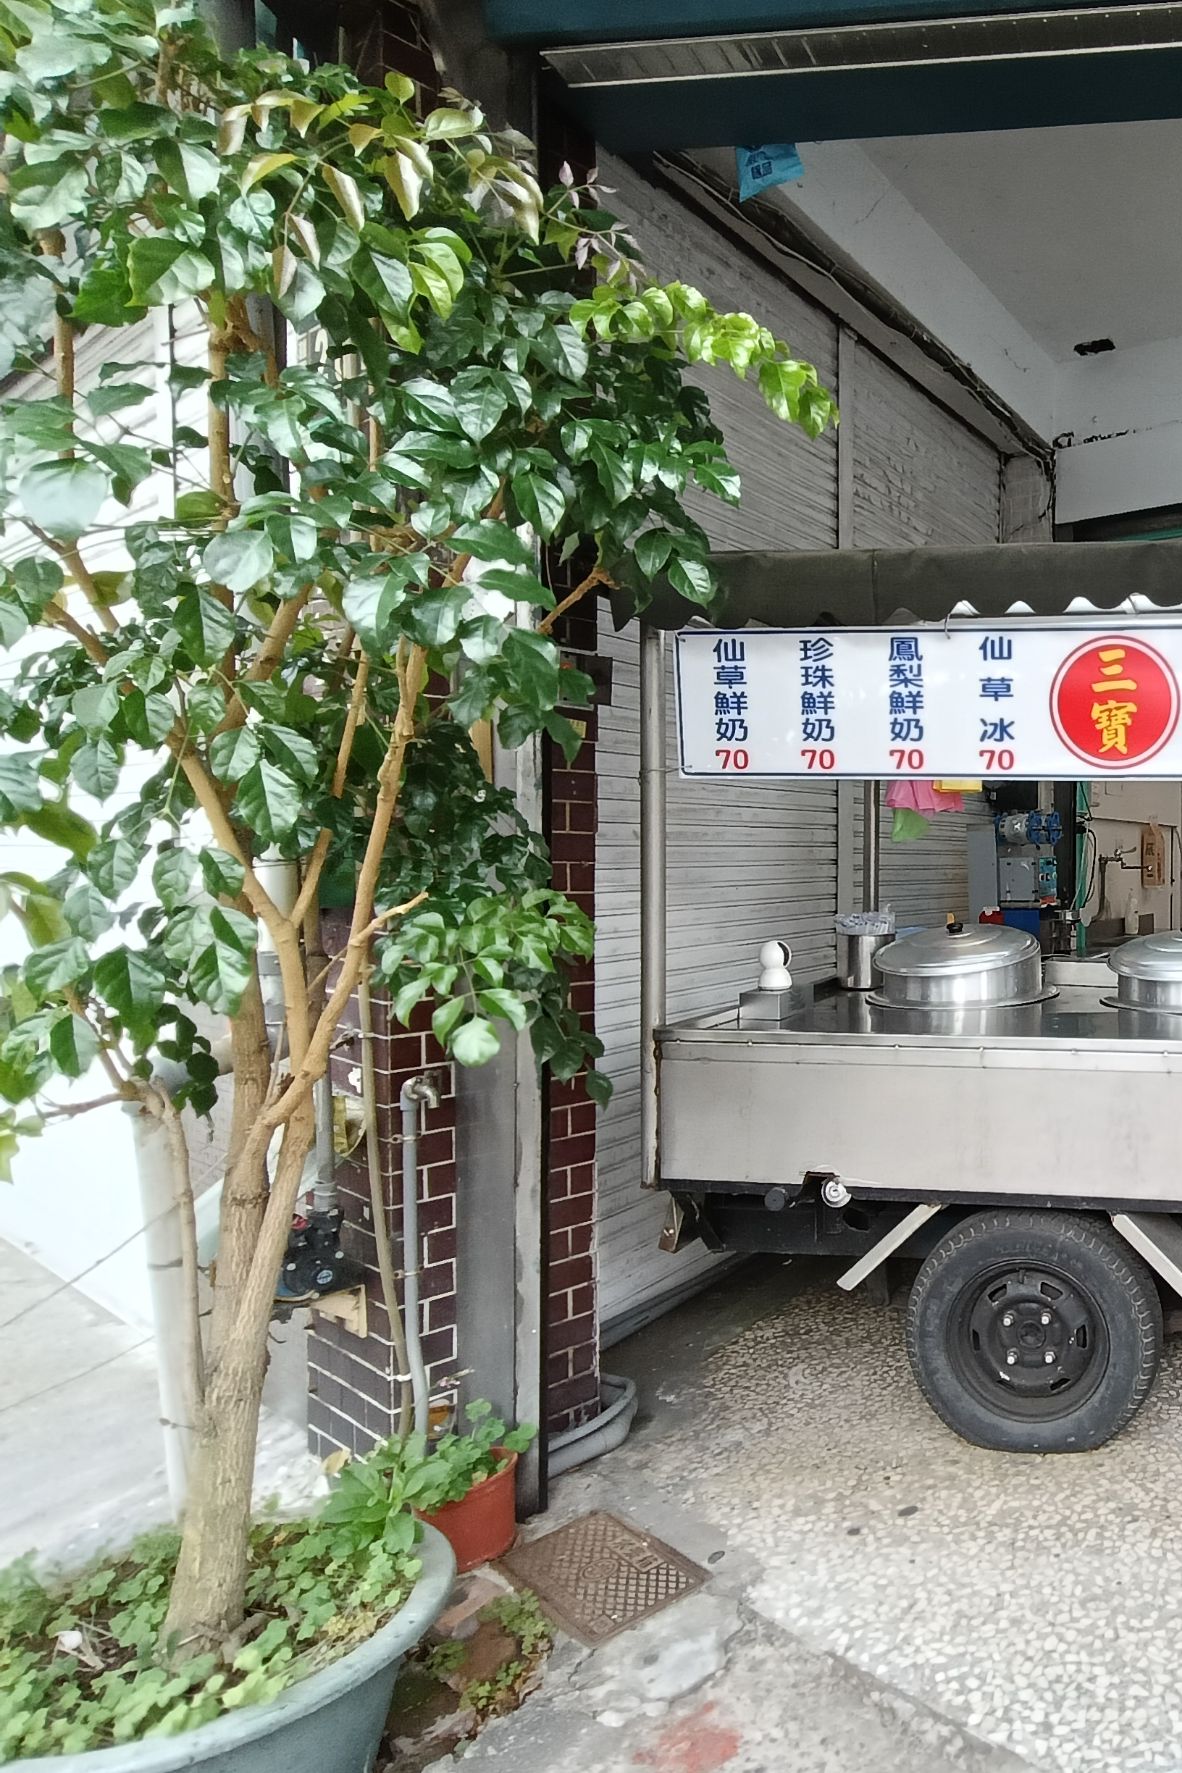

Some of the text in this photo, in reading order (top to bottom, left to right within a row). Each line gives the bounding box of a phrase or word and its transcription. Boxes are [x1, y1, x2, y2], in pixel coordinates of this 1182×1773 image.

[713, 638, 749, 771] 仙草鮮奶 70
[799, 638, 835, 771] 珍珠鮮奶 70
[888, 636, 925, 771] 鳳梨鮮奶 70
[978, 636, 1015, 771] 仙草冰 70
[1090, 648, 1139, 755] 三寶
